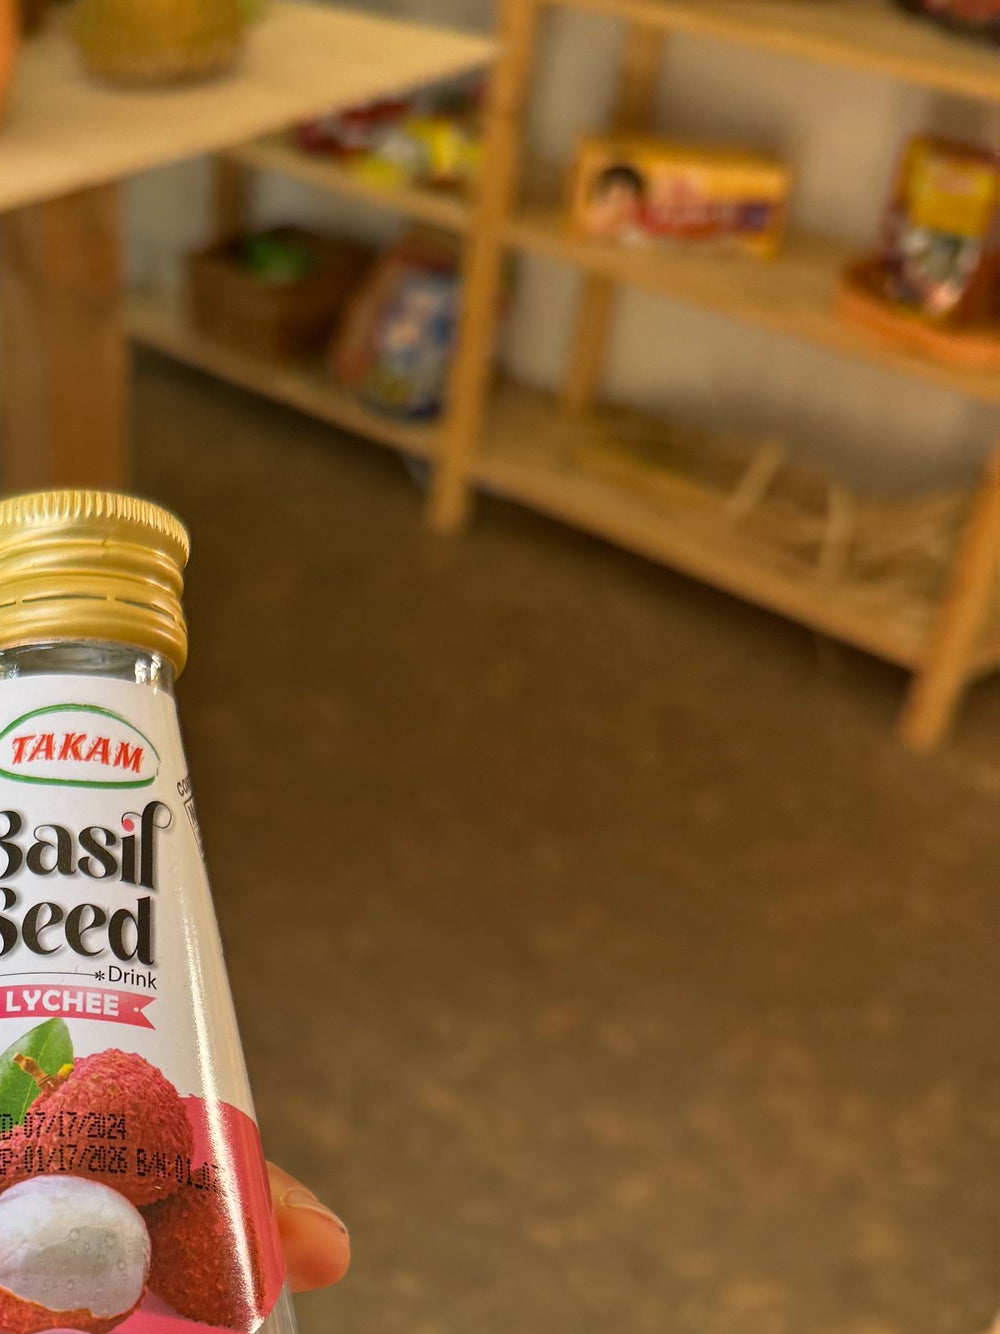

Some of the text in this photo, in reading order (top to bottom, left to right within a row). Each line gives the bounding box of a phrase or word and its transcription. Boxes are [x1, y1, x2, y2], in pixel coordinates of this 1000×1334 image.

[11, 732, 144, 774] TAKAM
[107, 965, 157, 990] Drink
[5, 989, 119, 1017] LYCHEE
